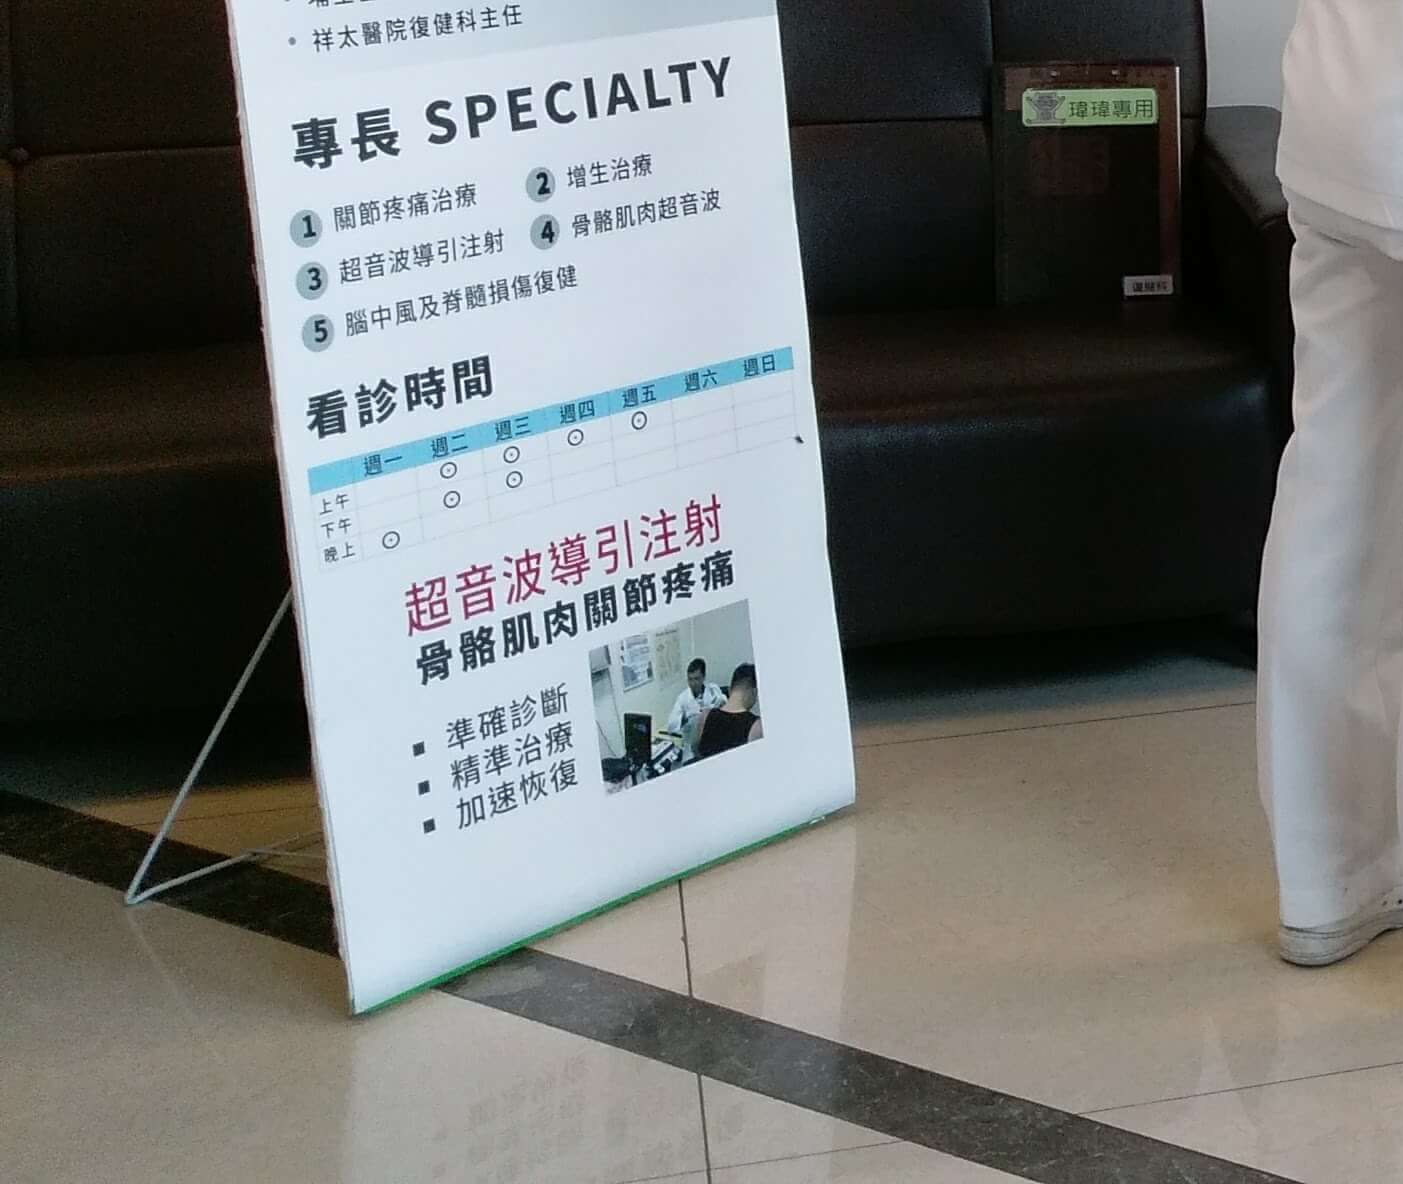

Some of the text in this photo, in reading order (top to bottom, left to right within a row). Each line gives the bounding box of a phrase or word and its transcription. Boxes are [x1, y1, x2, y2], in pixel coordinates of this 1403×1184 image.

[312, 4, 523, 52] 祥太醫院復健科主任
[292, 56, 732, 171] 專長 SPECIALTY
[535, 153, 653, 195] 2 增生治療
[303, 183, 477, 238] 1 關節疼痛治療
[540, 188, 721, 243] 4 骨骼肌肉超音波
[307, 228, 504, 291] 3 超音波導引注射
[314, 264, 578, 343] 5 腦中風及脊髓損傷復健
[306, 354, 493, 441] 看診時間
[363, 354, 776, 477] 週一 週二 週三 週四 週五 週六 週日
[319, 494, 349, 514] 上午
[322, 518, 352, 539] 下午
[324, 542, 356, 563] 晚上
[405, 493, 721, 637] 超音波導引注射
[417, 549, 734, 686] 骨骼肌肉關節疼痛
[445, 682, 569, 750] 準確診斷
[450, 721, 574, 791] 精準治療
[456, 758, 578, 830] 加速恢復
